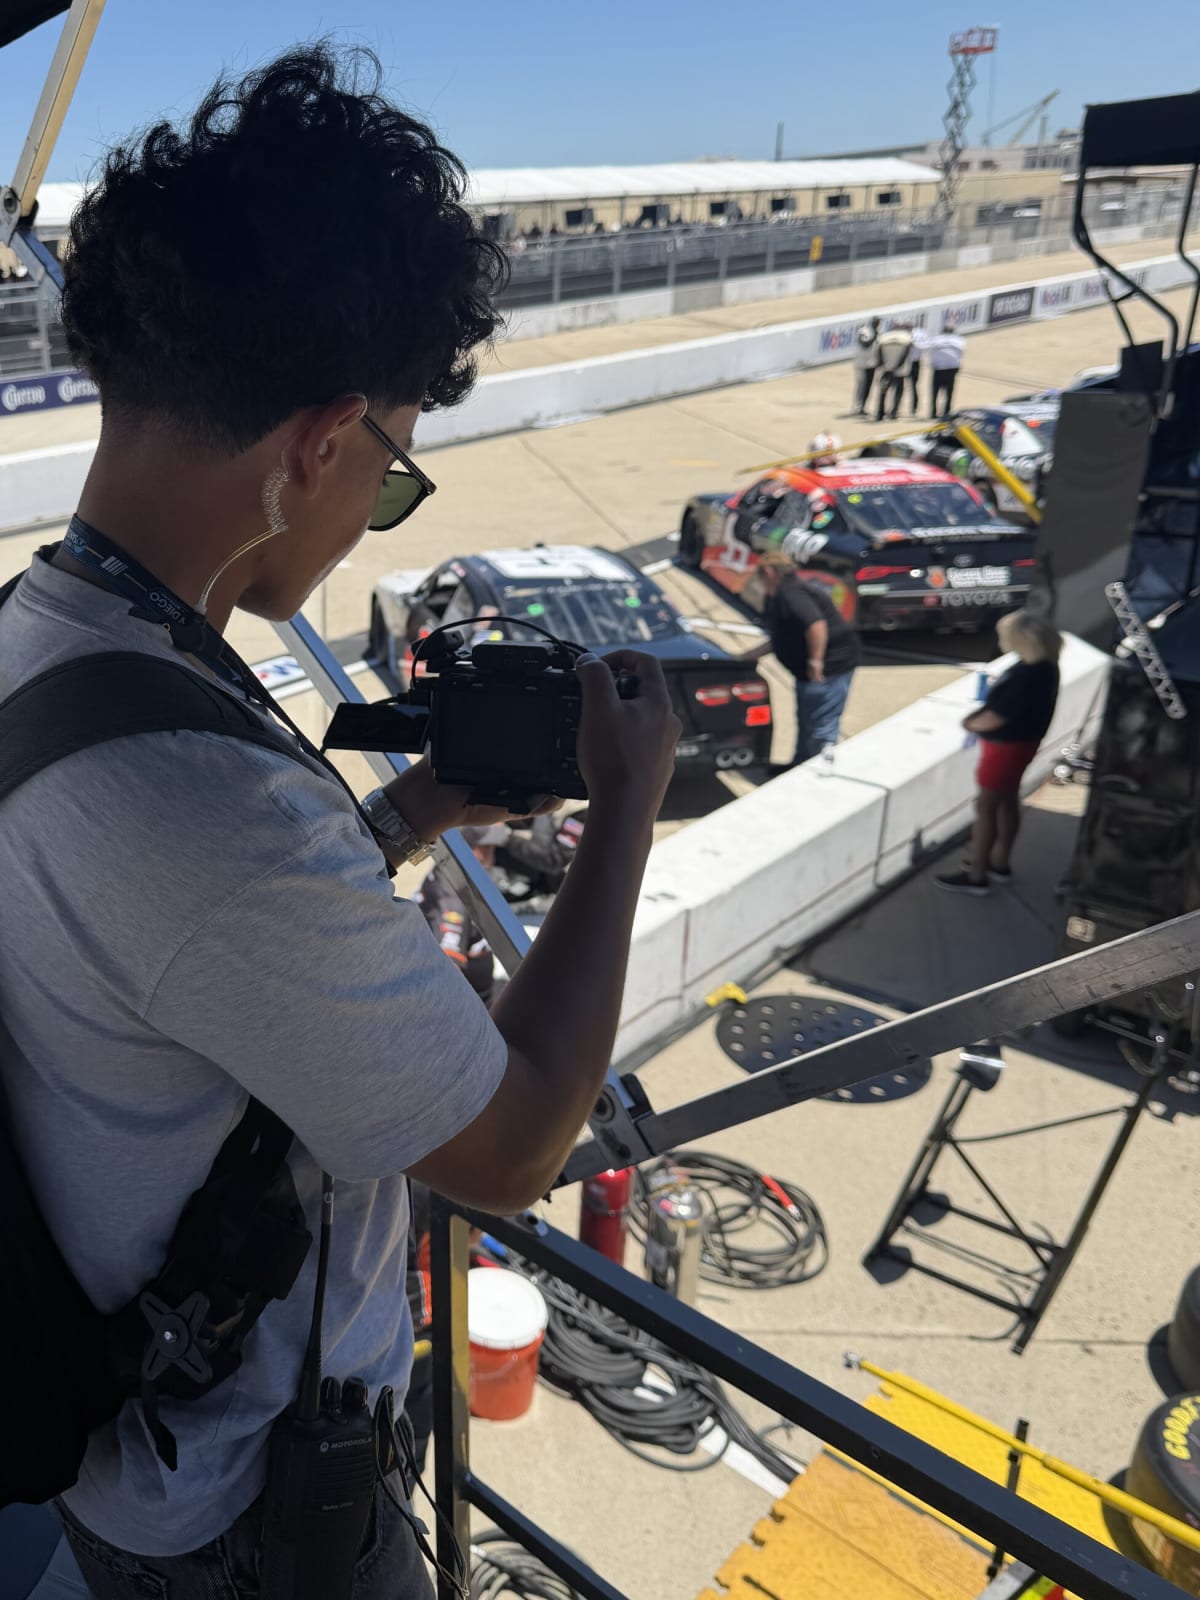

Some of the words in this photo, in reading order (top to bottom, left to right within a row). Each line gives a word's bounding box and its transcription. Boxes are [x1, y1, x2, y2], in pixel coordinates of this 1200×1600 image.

[150, 592, 181, 621] DIEGO
[941, 590, 1010, 607] TOYOTA
[330, 1437, 372, 1449] MOTOROLA
